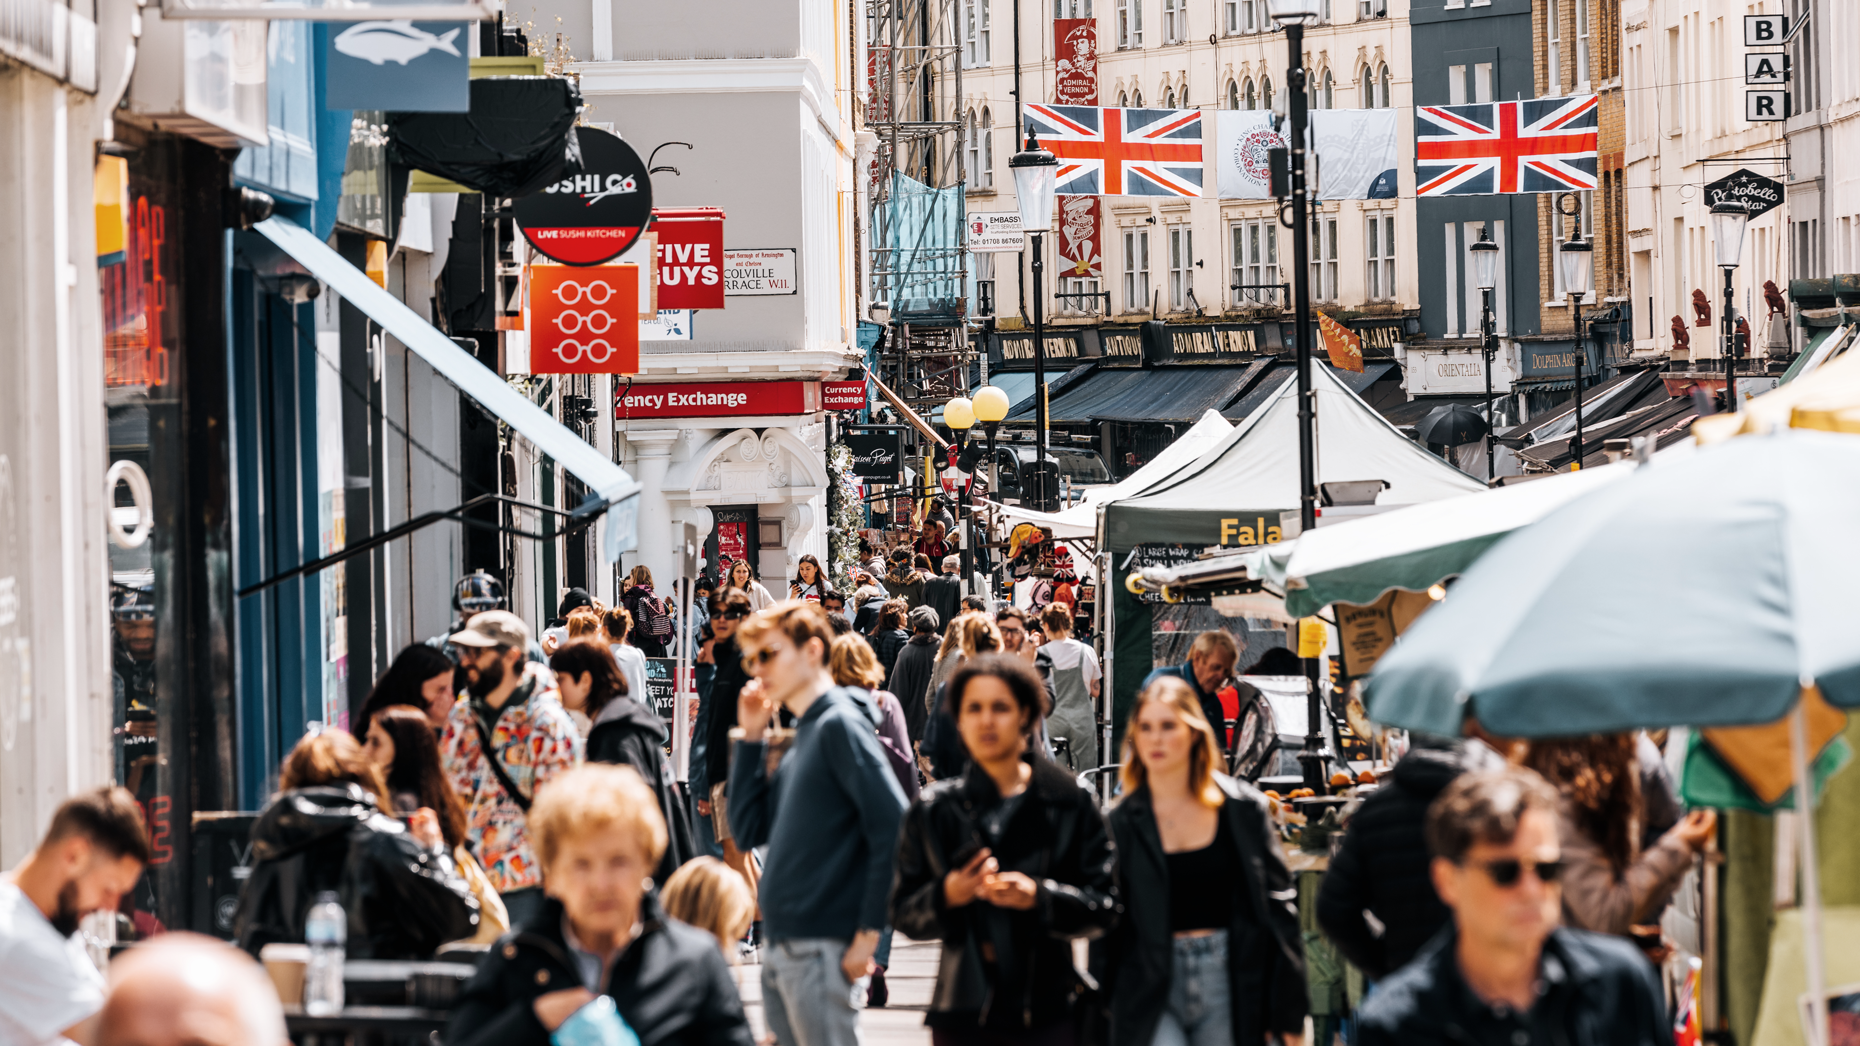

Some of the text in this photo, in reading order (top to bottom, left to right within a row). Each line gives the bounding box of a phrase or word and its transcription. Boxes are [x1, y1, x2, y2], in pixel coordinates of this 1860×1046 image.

[1753, 20, 1778, 116] BAR
[1237, 127, 1253, 143] KING
[1233, 148, 1262, 187] CORONATION
[1711, 182, 1778, 203] Ptobello
[1069, 219, 1093, 228] ANTIQUES
[538, 230, 626, 239] LIVE SUSHI KITCHEN
[736, 252, 754, 260] Borough
[656, 265, 719, 286] UYS
[724, 268, 774, 279] COLVILLE
[1172, 330, 1257, 354] ADMIRAL VERNON
[1360, 326, 1402, 349] MARKET
[1002, 338, 1035, 360] ADMIRA
[1532, 352, 1588, 369] DOLPHIN ARCE
[1437, 362, 1482, 378] ORIENTALIA
[824, 385, 863, 396] Currency
[667, 390, 747, 408] Exchange
[824, 395, 864, 405] Exchange
[853, 454, 872, 463] aison
[727, 471, 763, 491] BANK
[1143, 547, 1167, 558] LARGE
[1168, 547, 1190, 558] WRAP
